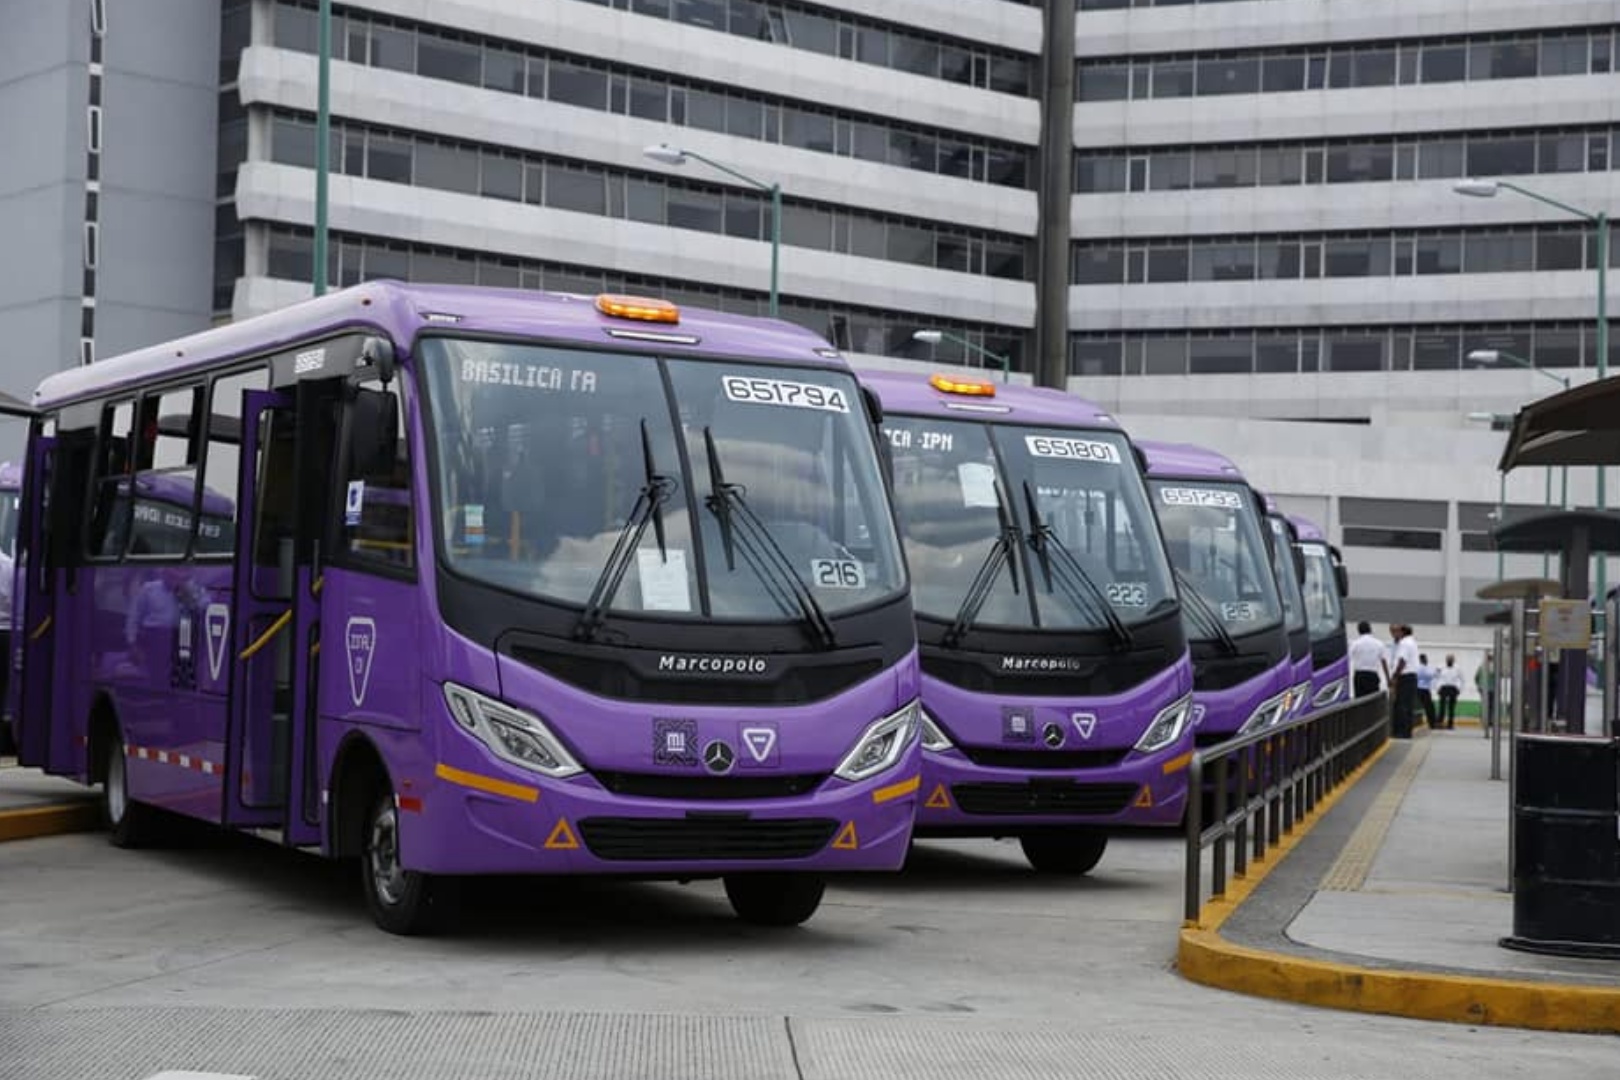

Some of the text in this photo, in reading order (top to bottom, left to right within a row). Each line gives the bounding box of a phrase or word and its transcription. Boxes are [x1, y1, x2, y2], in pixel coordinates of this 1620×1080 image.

[461, 359, 562, 391] BASILICA
[727, 378, 845, 411] 651794
[1033, 438, 1113, 462] 651801
[818, 561, 859, 585] 216
[1108, 585, 1145, 605] 223
[658, 654, 767, 672] Marcopolo
[1001, 656, 1081, 670] Marcopolo
